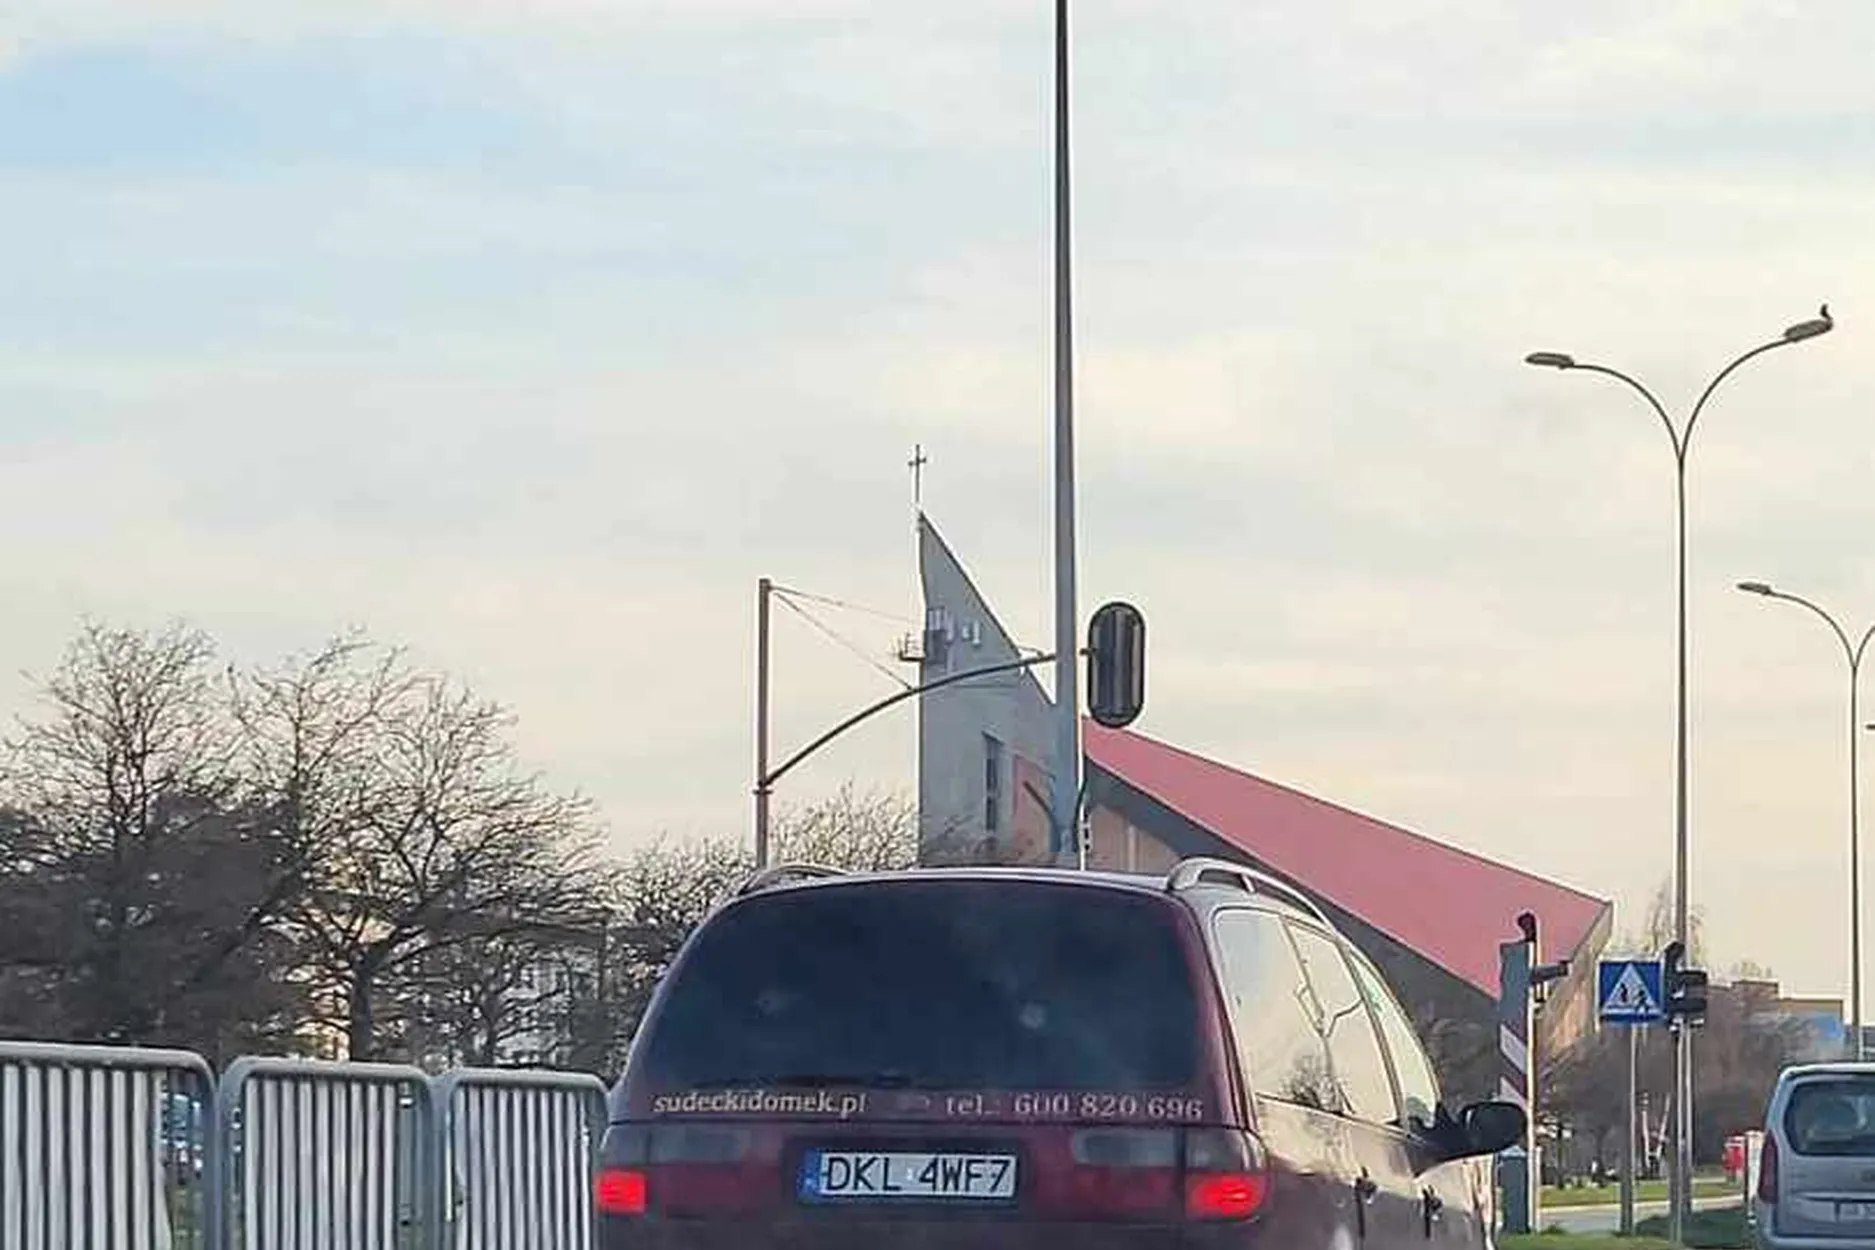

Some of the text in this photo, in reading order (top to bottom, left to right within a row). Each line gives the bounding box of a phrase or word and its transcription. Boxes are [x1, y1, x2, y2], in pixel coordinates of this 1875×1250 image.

[1014, 1094, 1070, 1116] 600
[1080, 1094, 1137, 1118] 820
[1149, 1096, 1204, 1120] 696
[826, 1156, 1011, 1193] DKL 4WF7
